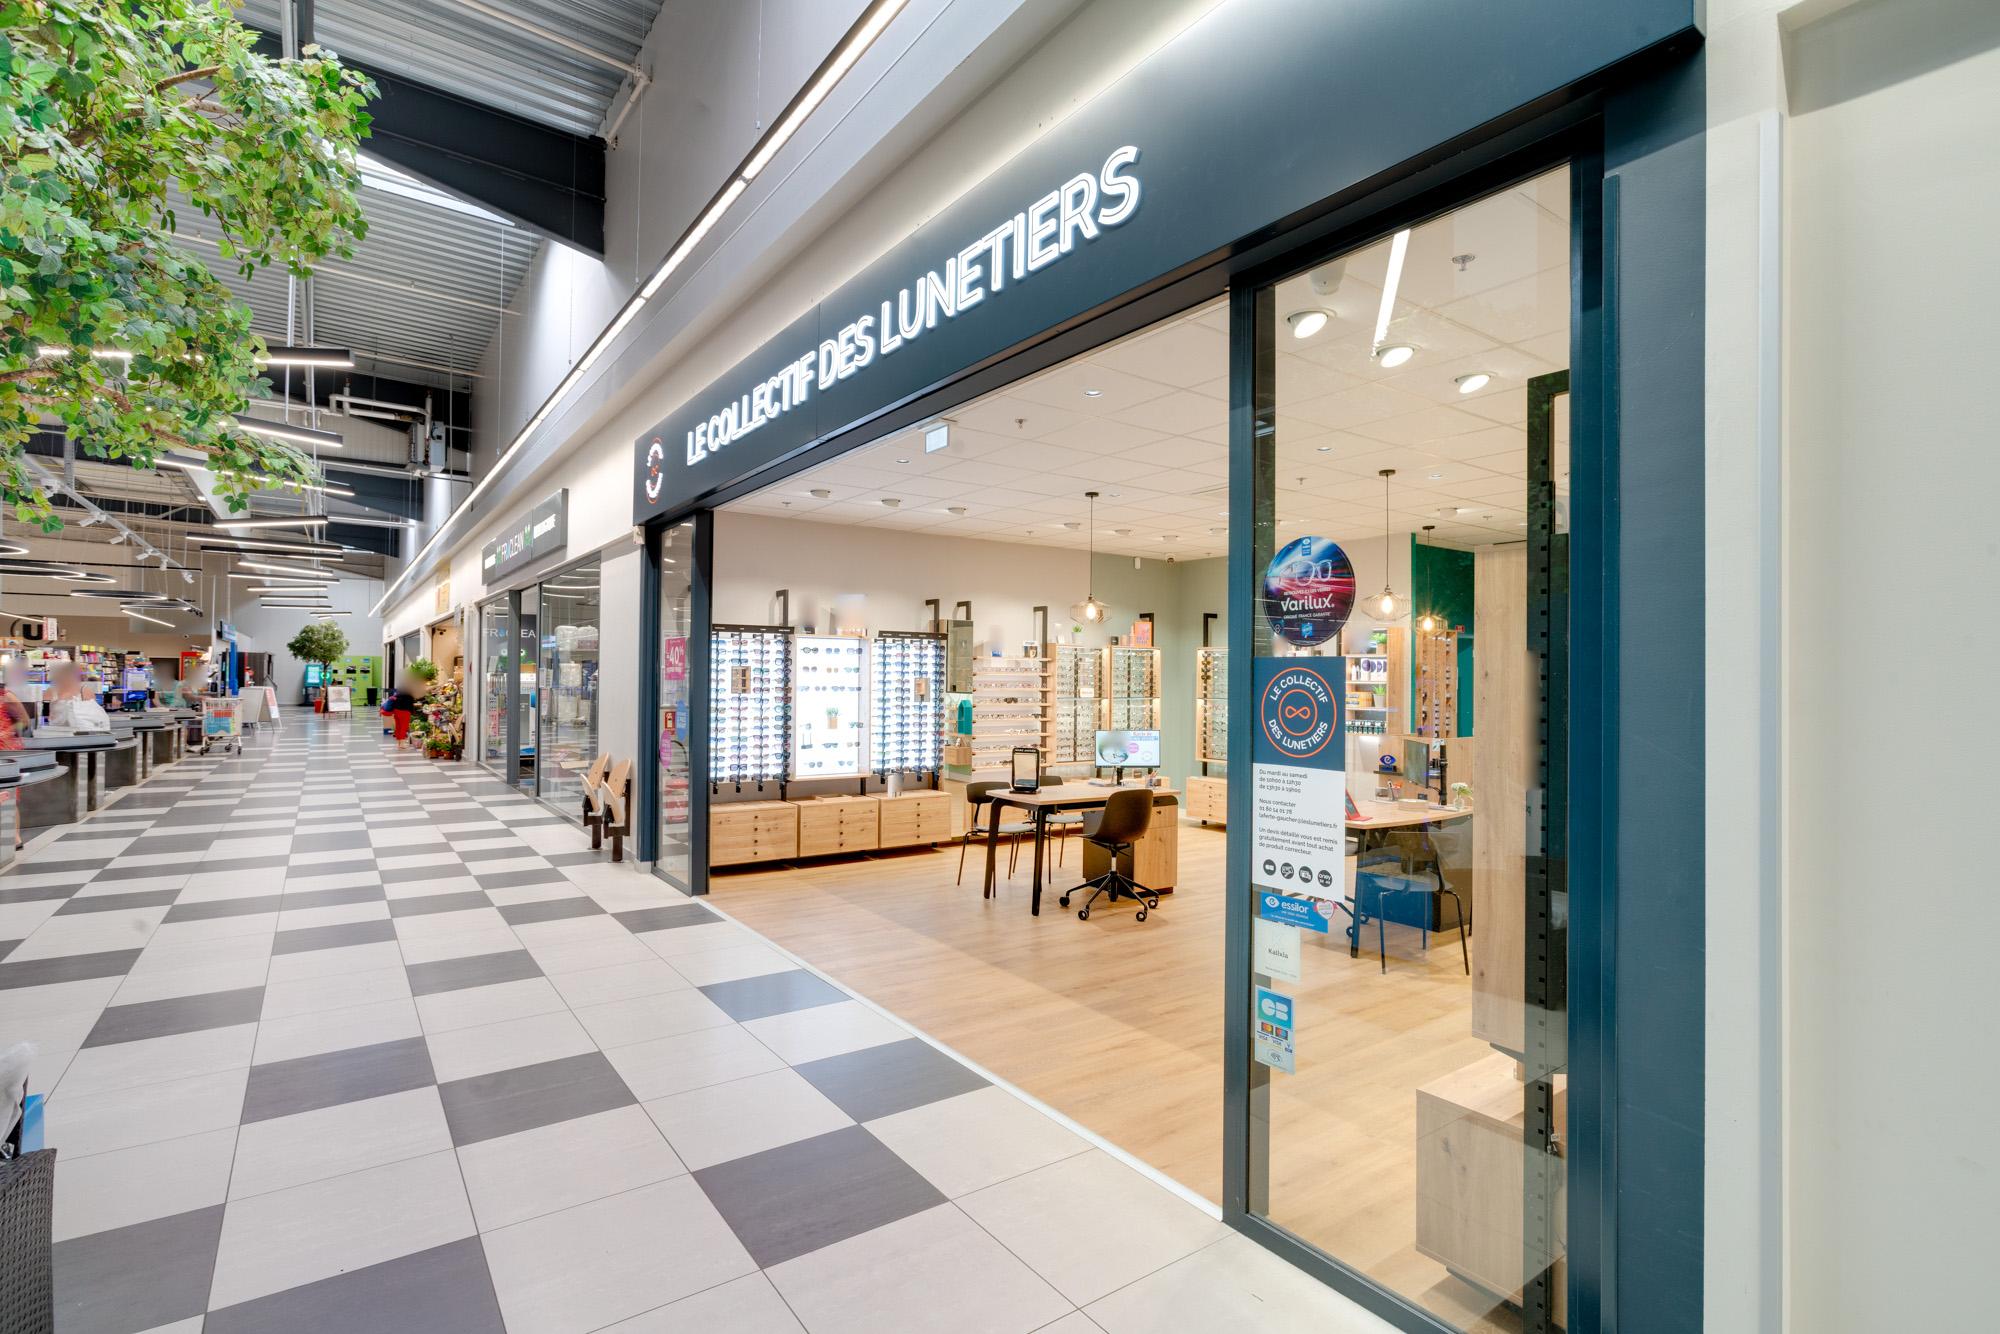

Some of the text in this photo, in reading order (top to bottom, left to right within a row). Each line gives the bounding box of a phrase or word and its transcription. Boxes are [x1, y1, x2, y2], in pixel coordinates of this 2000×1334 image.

[687, 144, 1142, 466] LE COLLECTIF DES LUNETIERS
[1269, 675, 1328, 703] LE COLLECTIF
[1268, 719, 1328, 750] DES LUNETIERS
[1272, 799, 1296, 807] contacter
[1259, 835, 1291, 844] gratuitement
[1322, 837, 1338, 845] remis
[1266, 843, 1284, 851] produit
[1281, 901, 1309, 914] essilor
